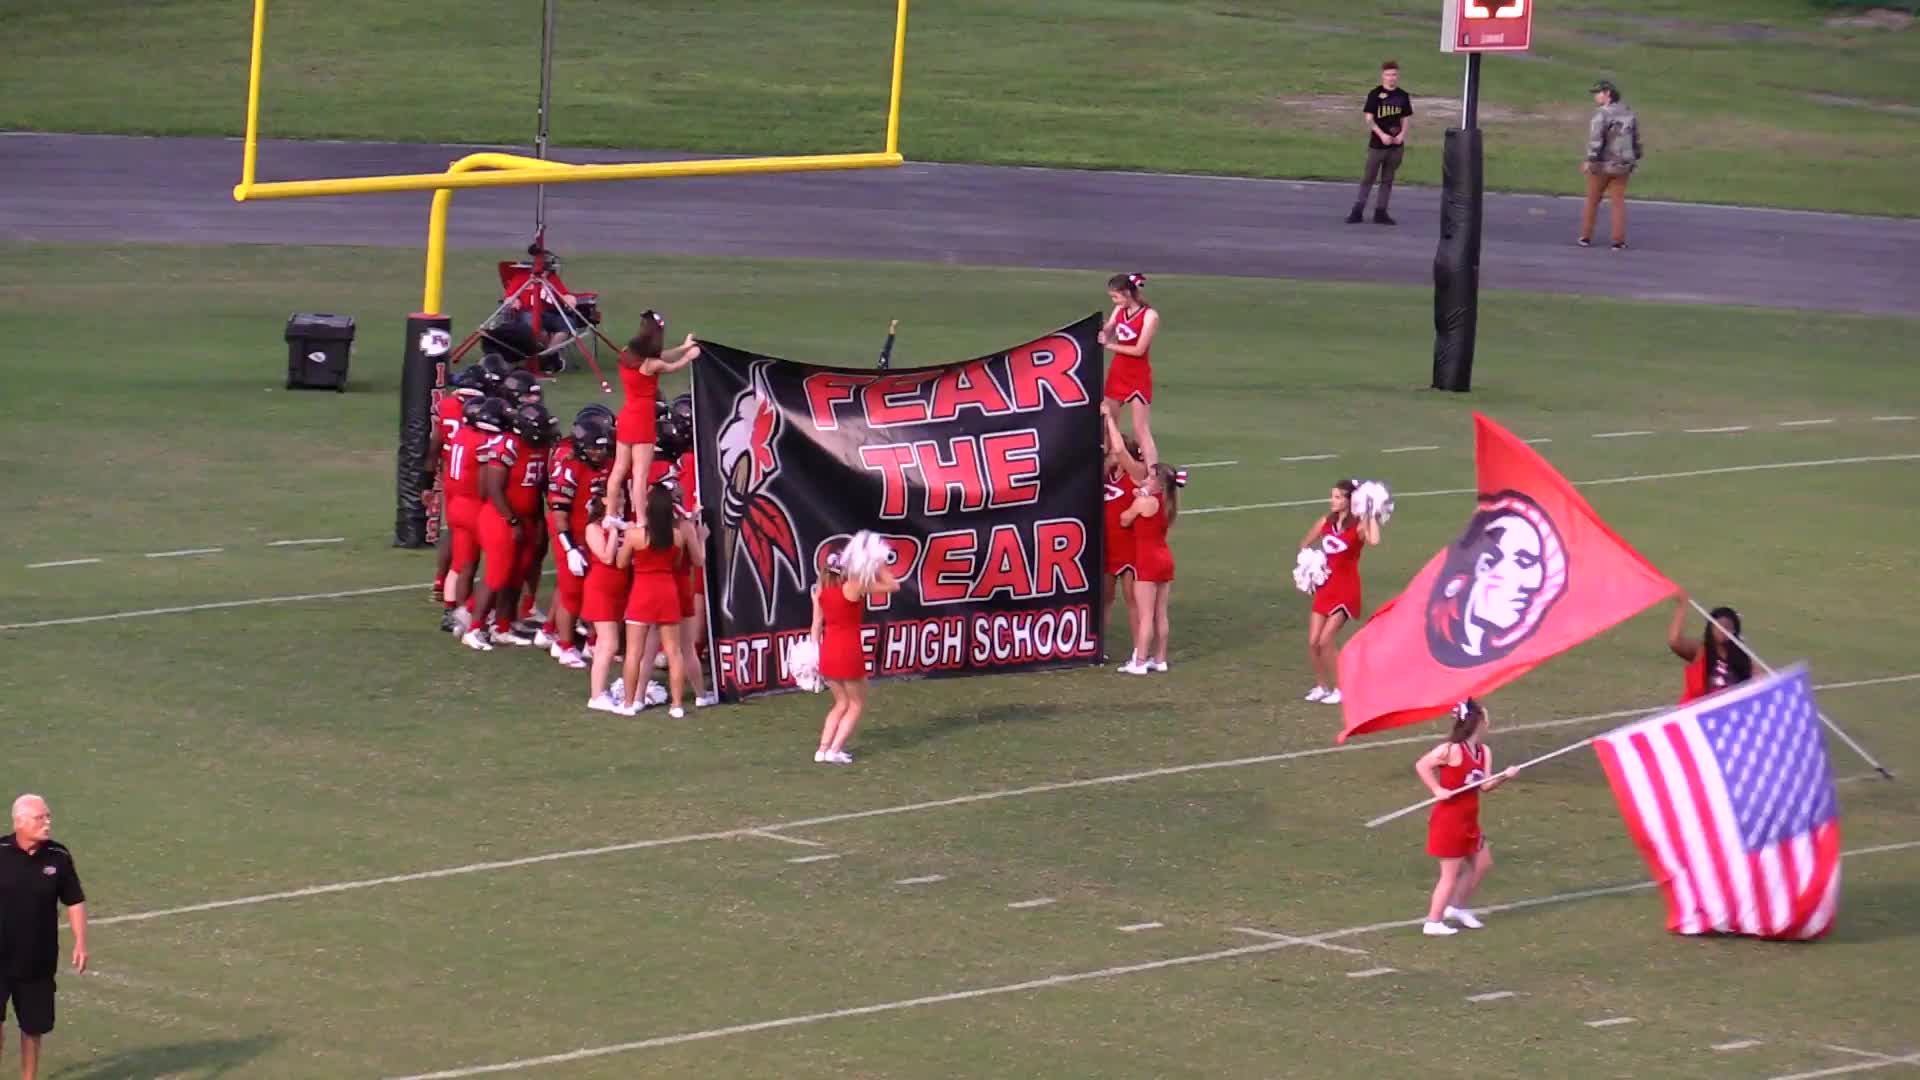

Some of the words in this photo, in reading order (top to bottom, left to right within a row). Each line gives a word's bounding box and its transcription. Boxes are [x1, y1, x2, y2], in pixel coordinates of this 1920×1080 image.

[803, 332, 1089, 431] FEAR
[449, 443, 464, 480] 11
[859, 429, 1040, 519] THE
[885, 619, 964, 671] HIGH
[972, 606, 1097, 664] SCHOOL
